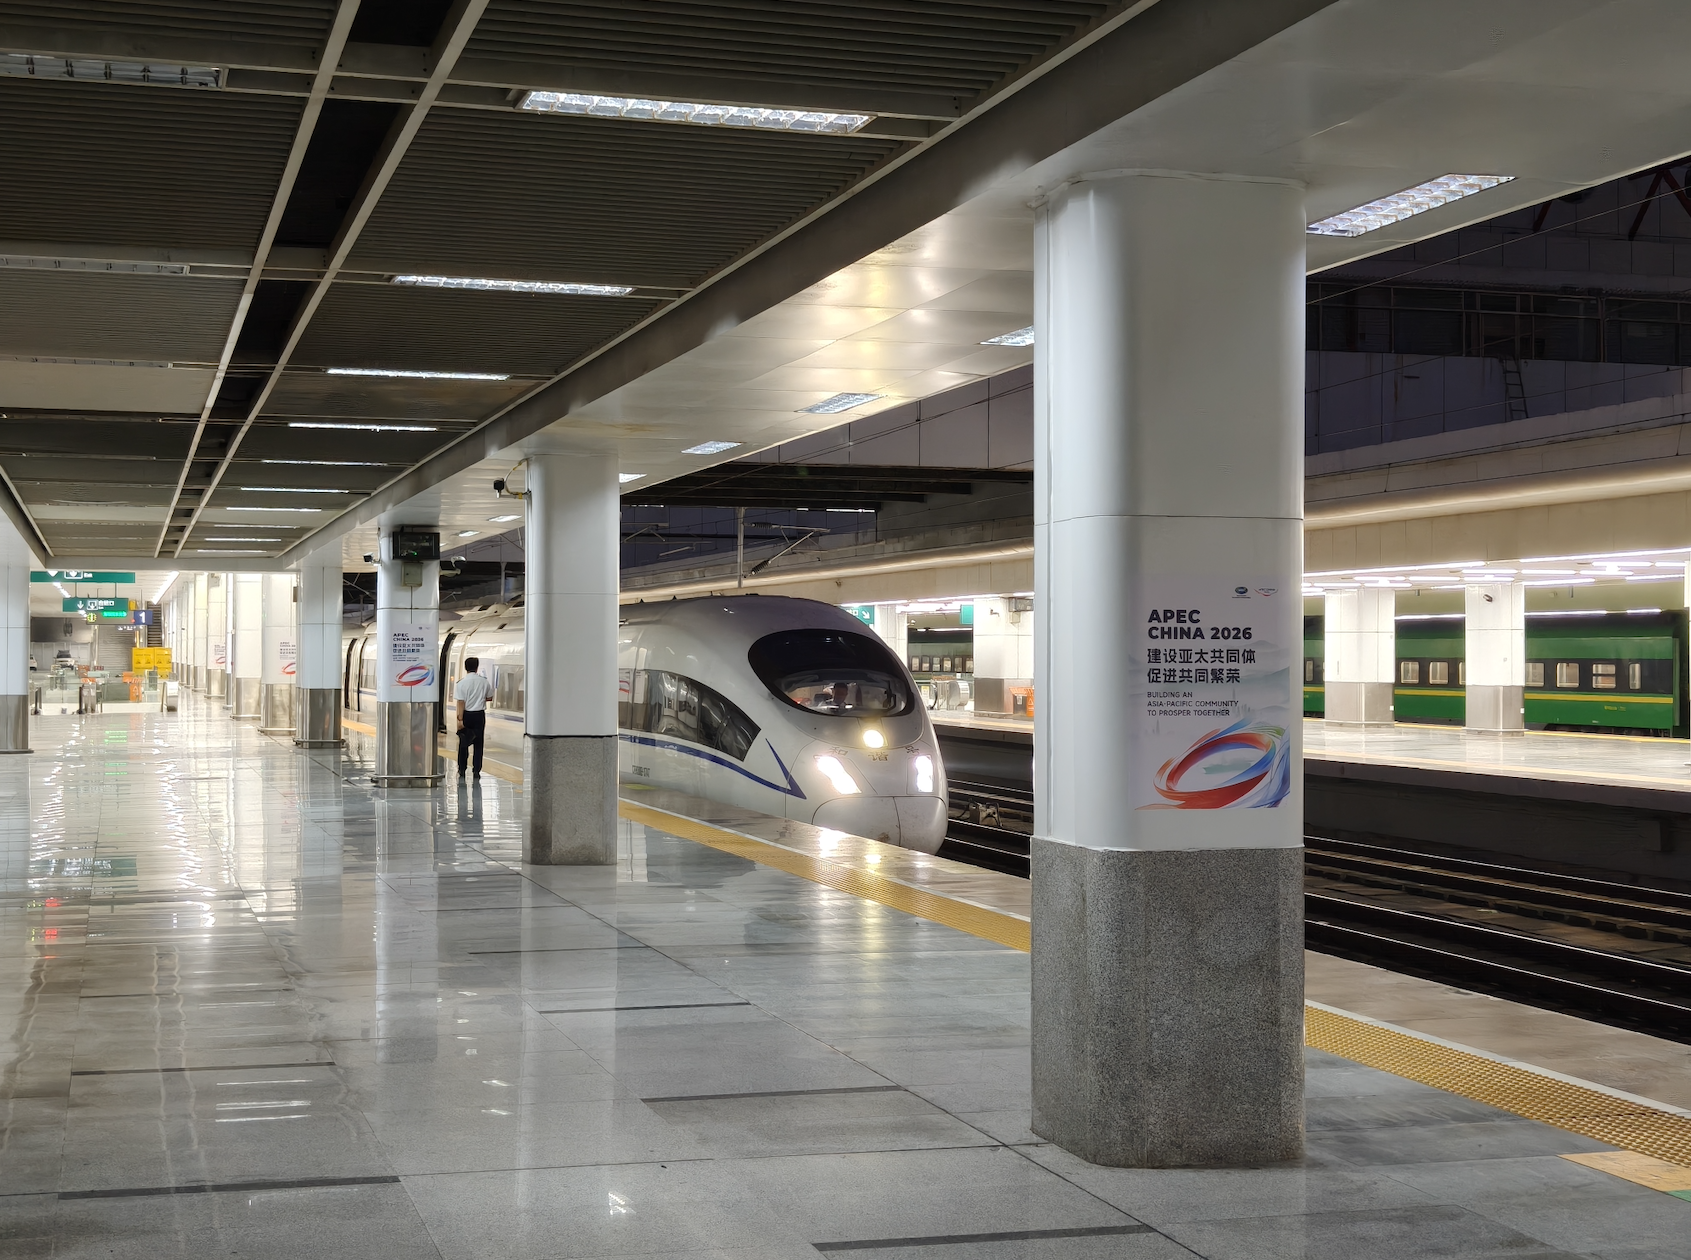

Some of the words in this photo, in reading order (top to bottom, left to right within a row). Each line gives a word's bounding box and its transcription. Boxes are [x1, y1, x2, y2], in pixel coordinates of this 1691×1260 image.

[139, 611, 146, 624] 1
[1148, 609, 1201, 624] APEC
[1148, 626, 1205, 640] CHINA
[1210, 626, 1253, 640] 2026
[1147, 648, 1256, 664] 建设亚太共同体
[1147, 668, 1241, 684] 促进共同繁荣
